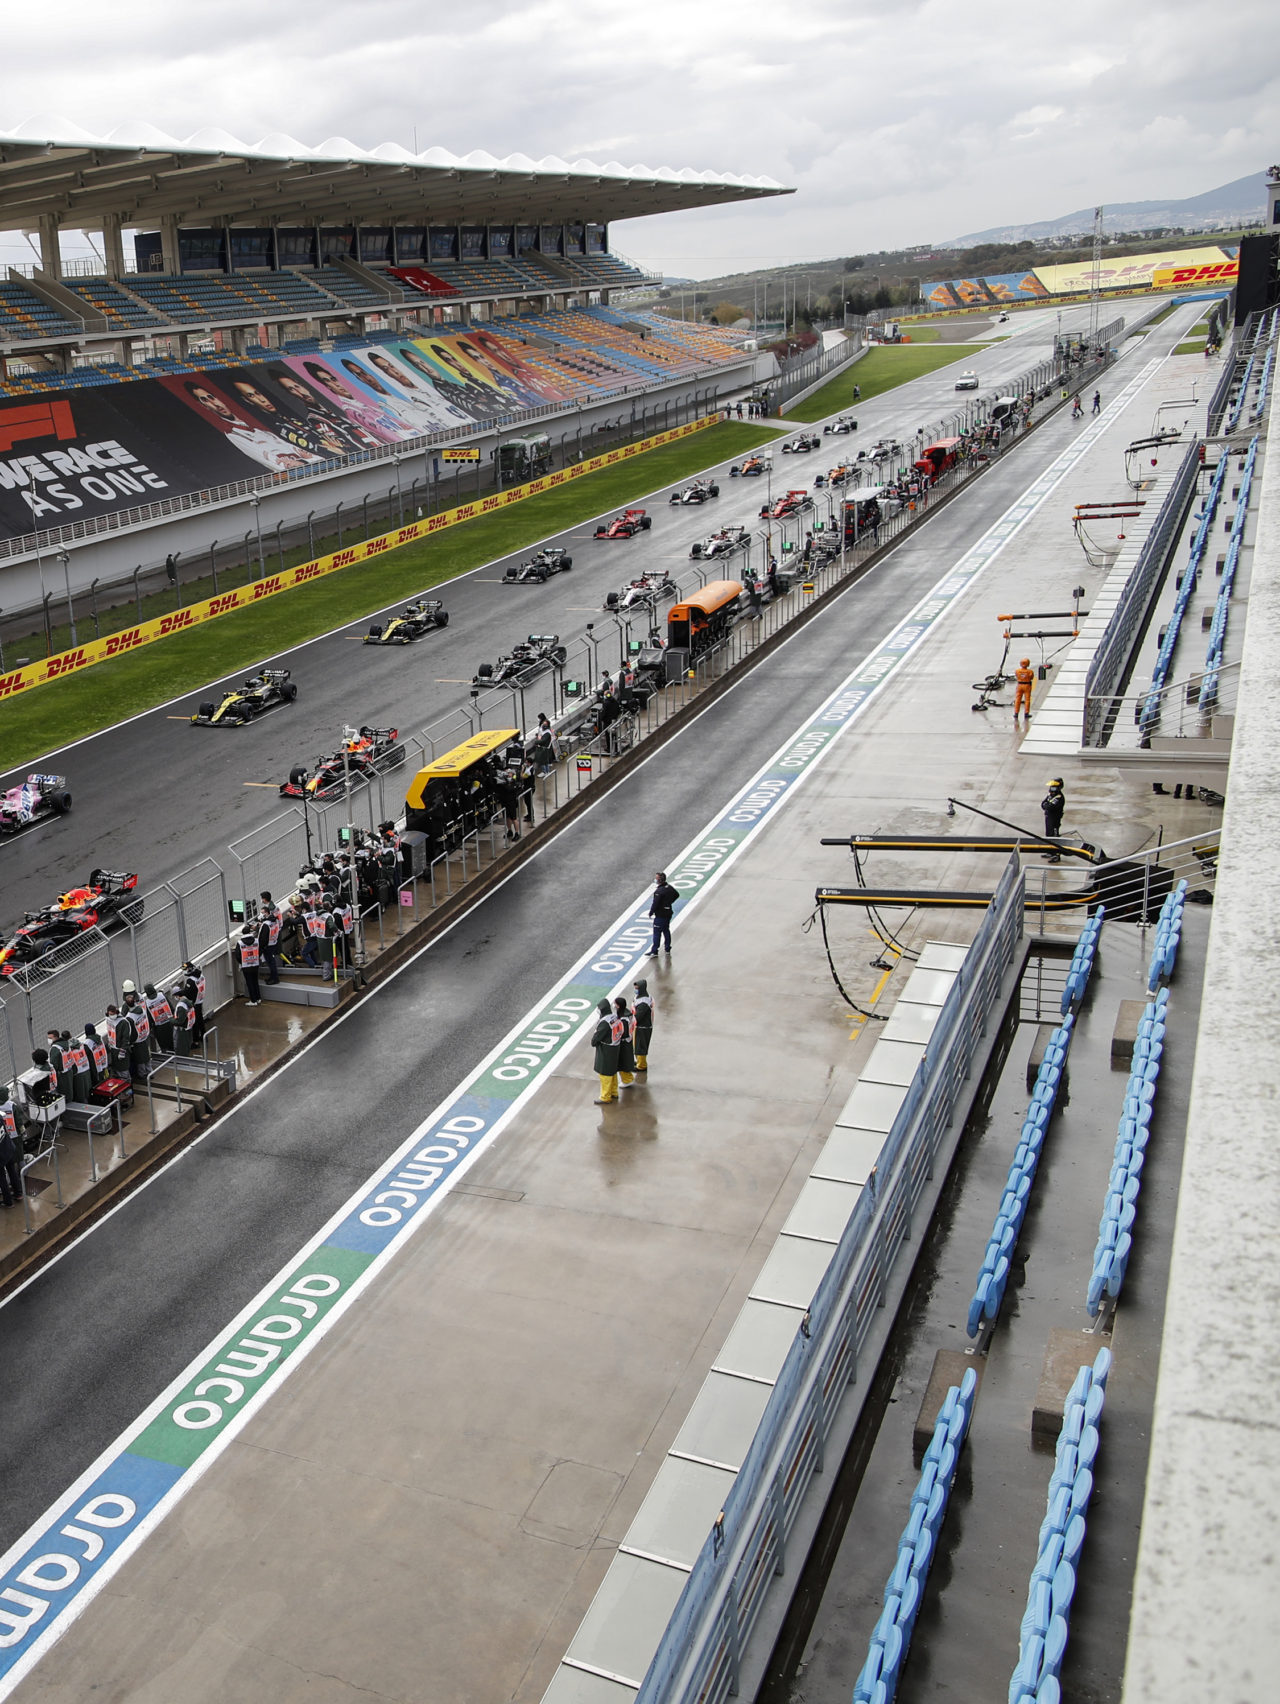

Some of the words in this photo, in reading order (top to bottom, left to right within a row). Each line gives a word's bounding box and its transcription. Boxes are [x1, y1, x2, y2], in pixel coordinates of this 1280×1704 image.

[1171, 263, 1239, 283] DHL
[42, 440, 138, 476] RACE
[21, 483, 83, 517] AS
[80, 464, 168, 500] ONE
[366, 538, 389, 556] DHL
[399, 526, 419, 543] DHL
[295, 563, 321, 583] DHL
[332, 550, 356, 569] DHL
[254, 577, 282, 599] DHL
[209, 594, 240, 616] DHL
[160, 610, 194, 635] DHL
[106, 630, 143, 656] DHL
[47, 649, 87, 678] DHL
[821, 690, 866, 721] aramco
[779, 731, 830, 767] aramco
[729, 779, 787, 822] aramco
[672, 838, 735, 889] aramco
[591, 909, 654, 973] amco
[492, 998, 591, 1081] aramco
[359, 1116, 485, 1227] aramco
[173, 1273, 340, 1430] aramco
